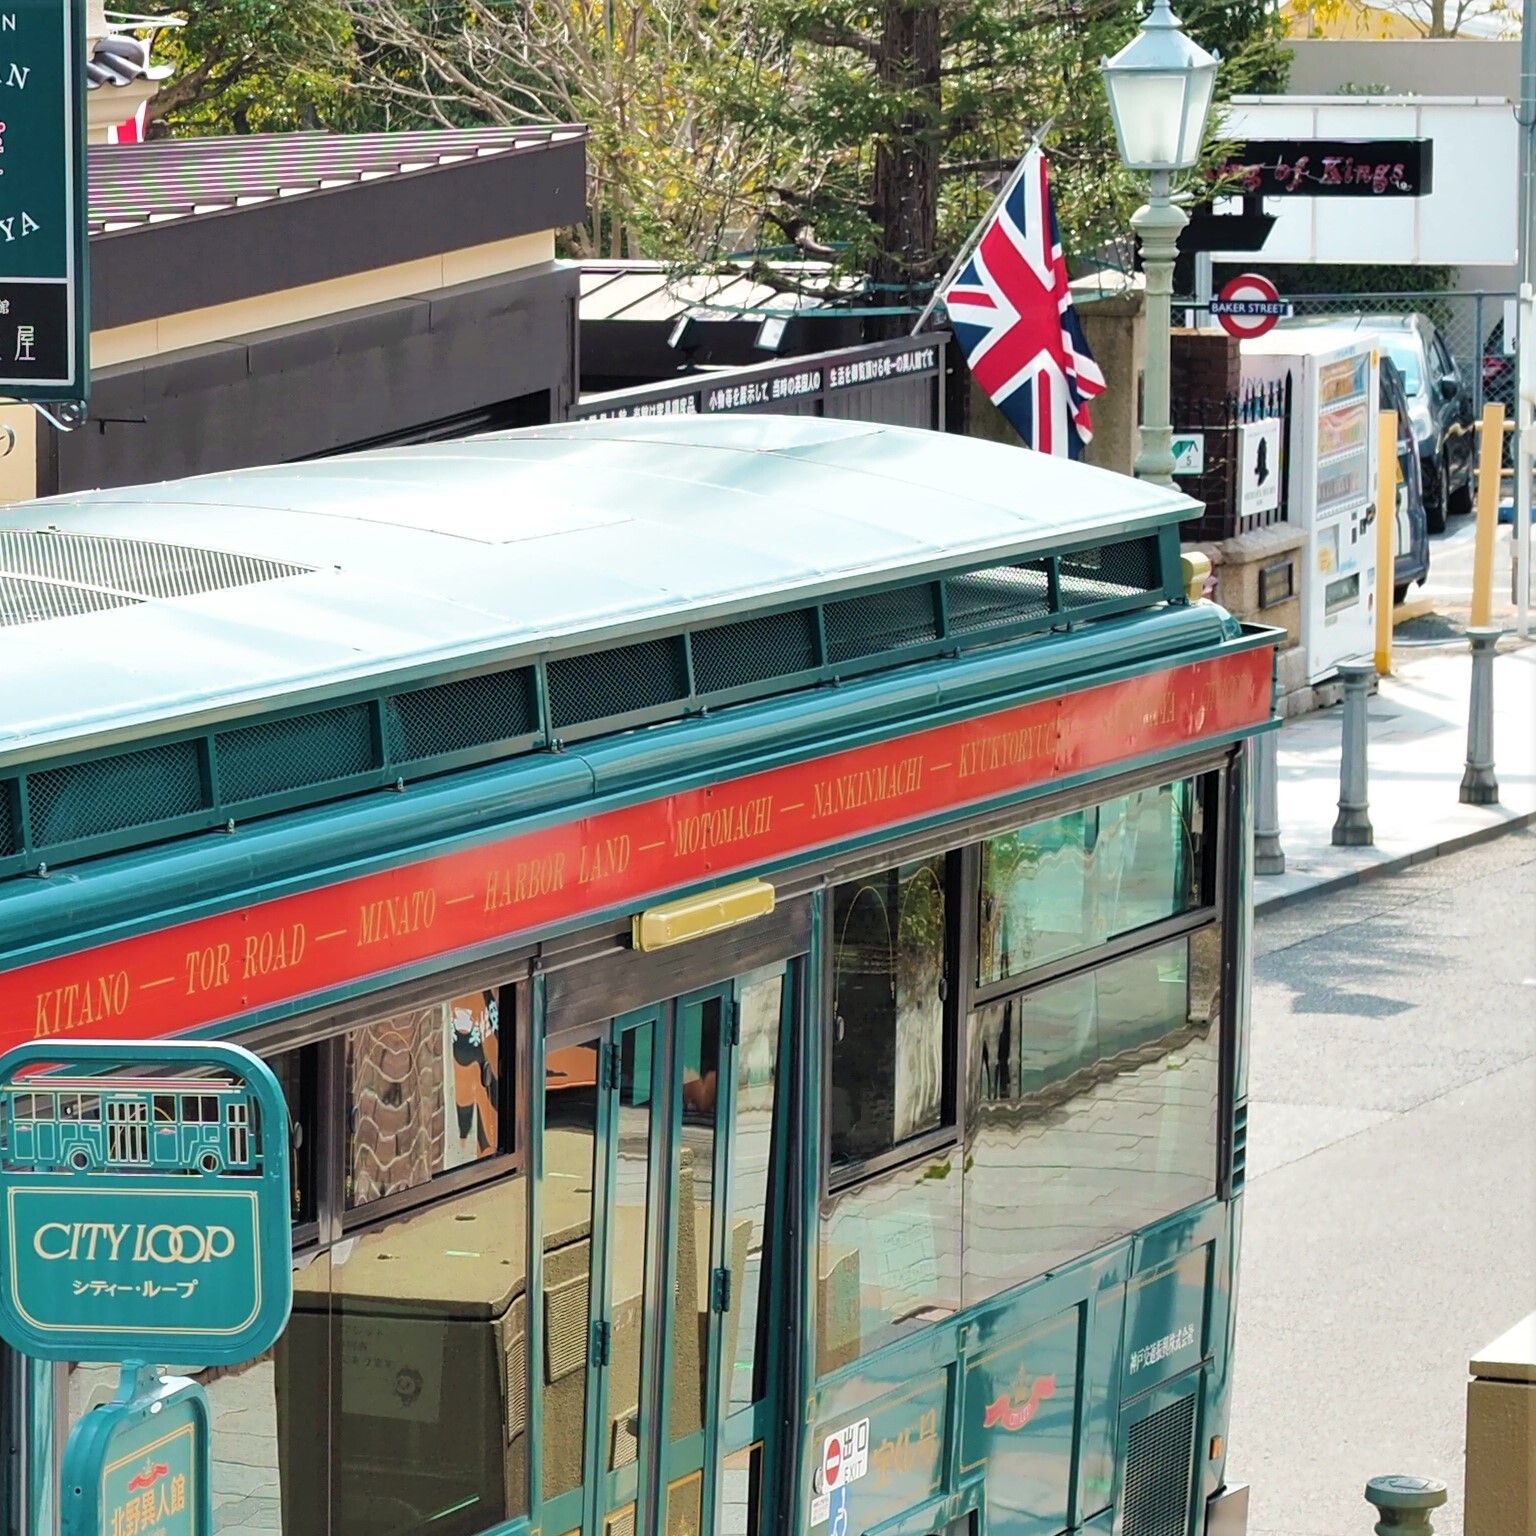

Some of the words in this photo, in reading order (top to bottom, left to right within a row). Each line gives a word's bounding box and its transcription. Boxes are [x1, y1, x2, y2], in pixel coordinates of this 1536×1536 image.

[1320, 156, 1406, 194] Kings
[1211, 302, 1246, 314] BAKER
[1249, 303, 1286, 315] STREET
[32, 970, 129, 1040] KITANO
[185, 943, 231, 996] TOR
[242, 923, 306, 979] ROAD
[356, 888, 437, 948] MINATO
[482, 854, 566, 912] HARBOR
[578, 834, 631, 885] LAND
[673, 796, 773, 858] MOTOMACHI
[810, 755, 924, 820] NANKINMACHI
[33, 1221, 128, 1261] CITY
[131, 1222, 236, 1264] LOOP
[72, 1279, 199, 1299] シティー・ループ
[842, 1420, 868, 1461] 出口
[844, 1459, 863, 1484] EXIT
